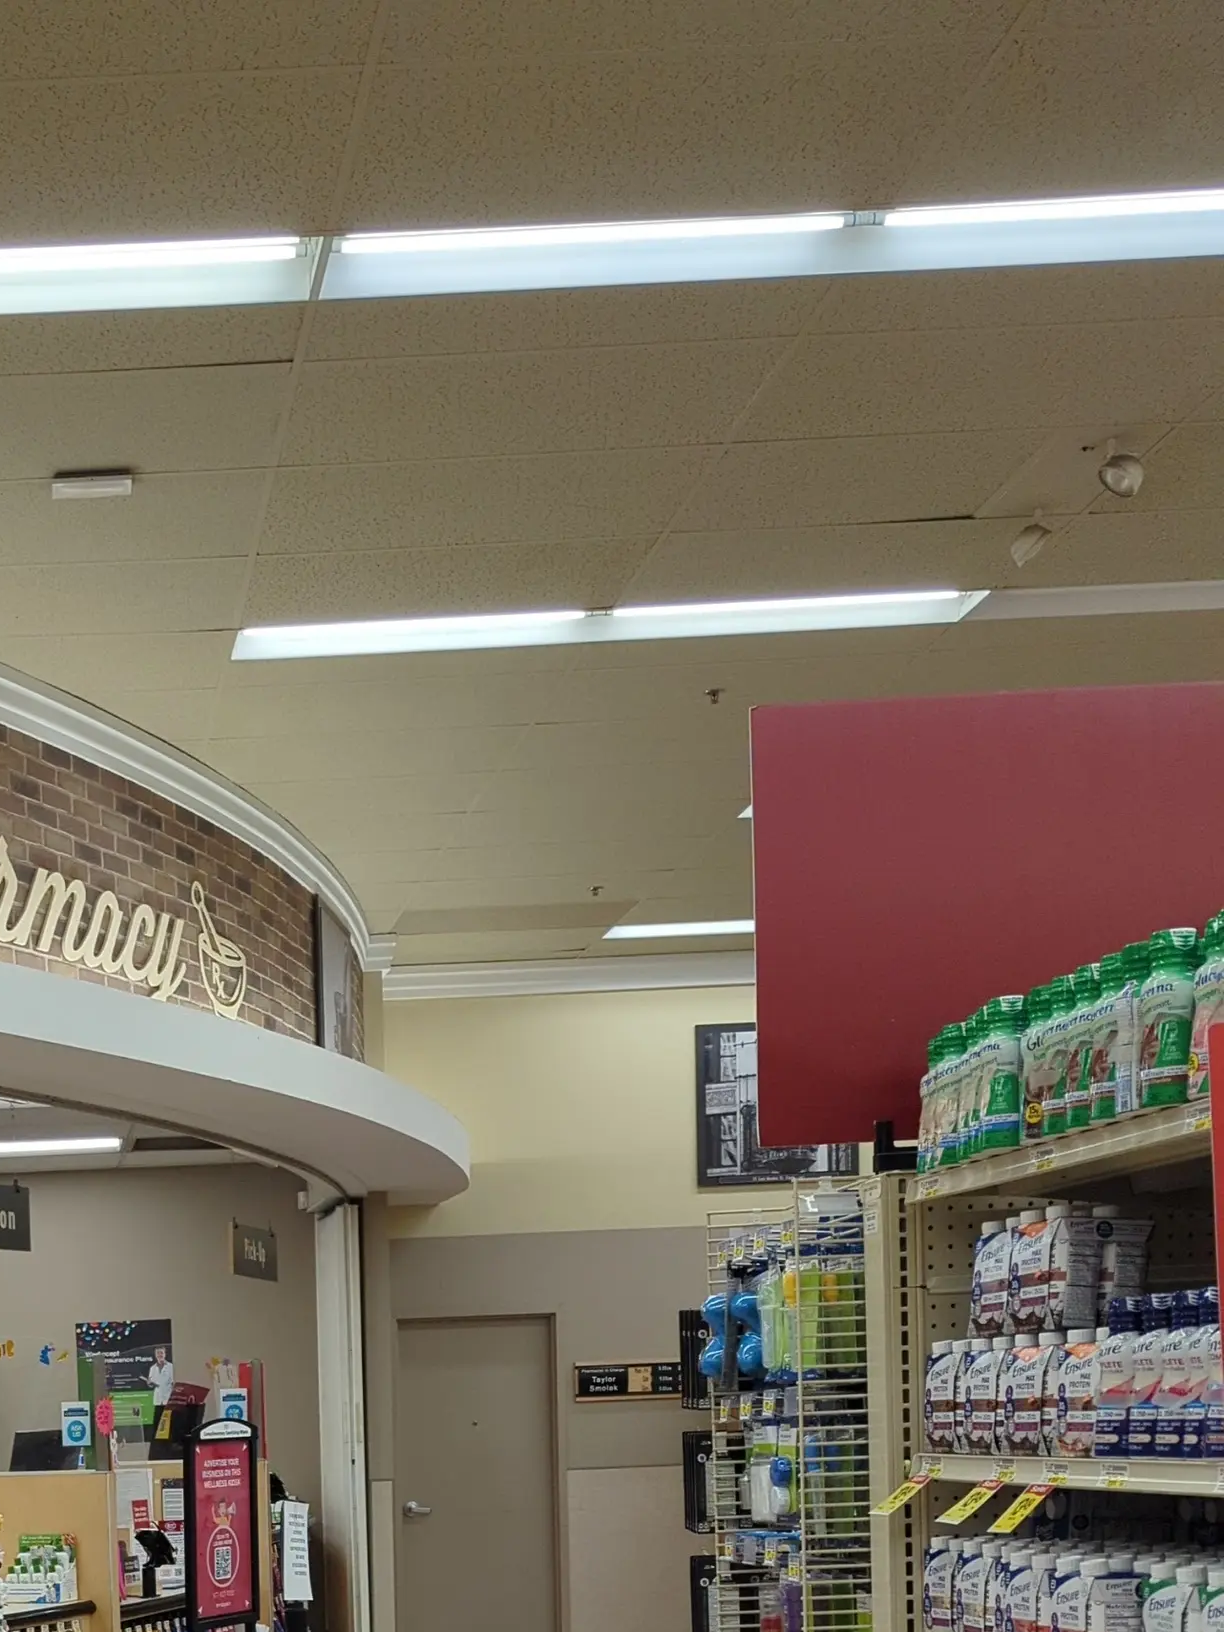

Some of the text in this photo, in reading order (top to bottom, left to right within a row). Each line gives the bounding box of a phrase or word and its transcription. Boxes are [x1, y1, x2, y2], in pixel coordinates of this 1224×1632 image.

[591, 1376, 617, 1384] Taylor
[589, 1385, 619, 1393] Smolak
[1057, 1590, 1080, 1605] Ensure
[1149, 1597, 1176, 1612] Ensure
